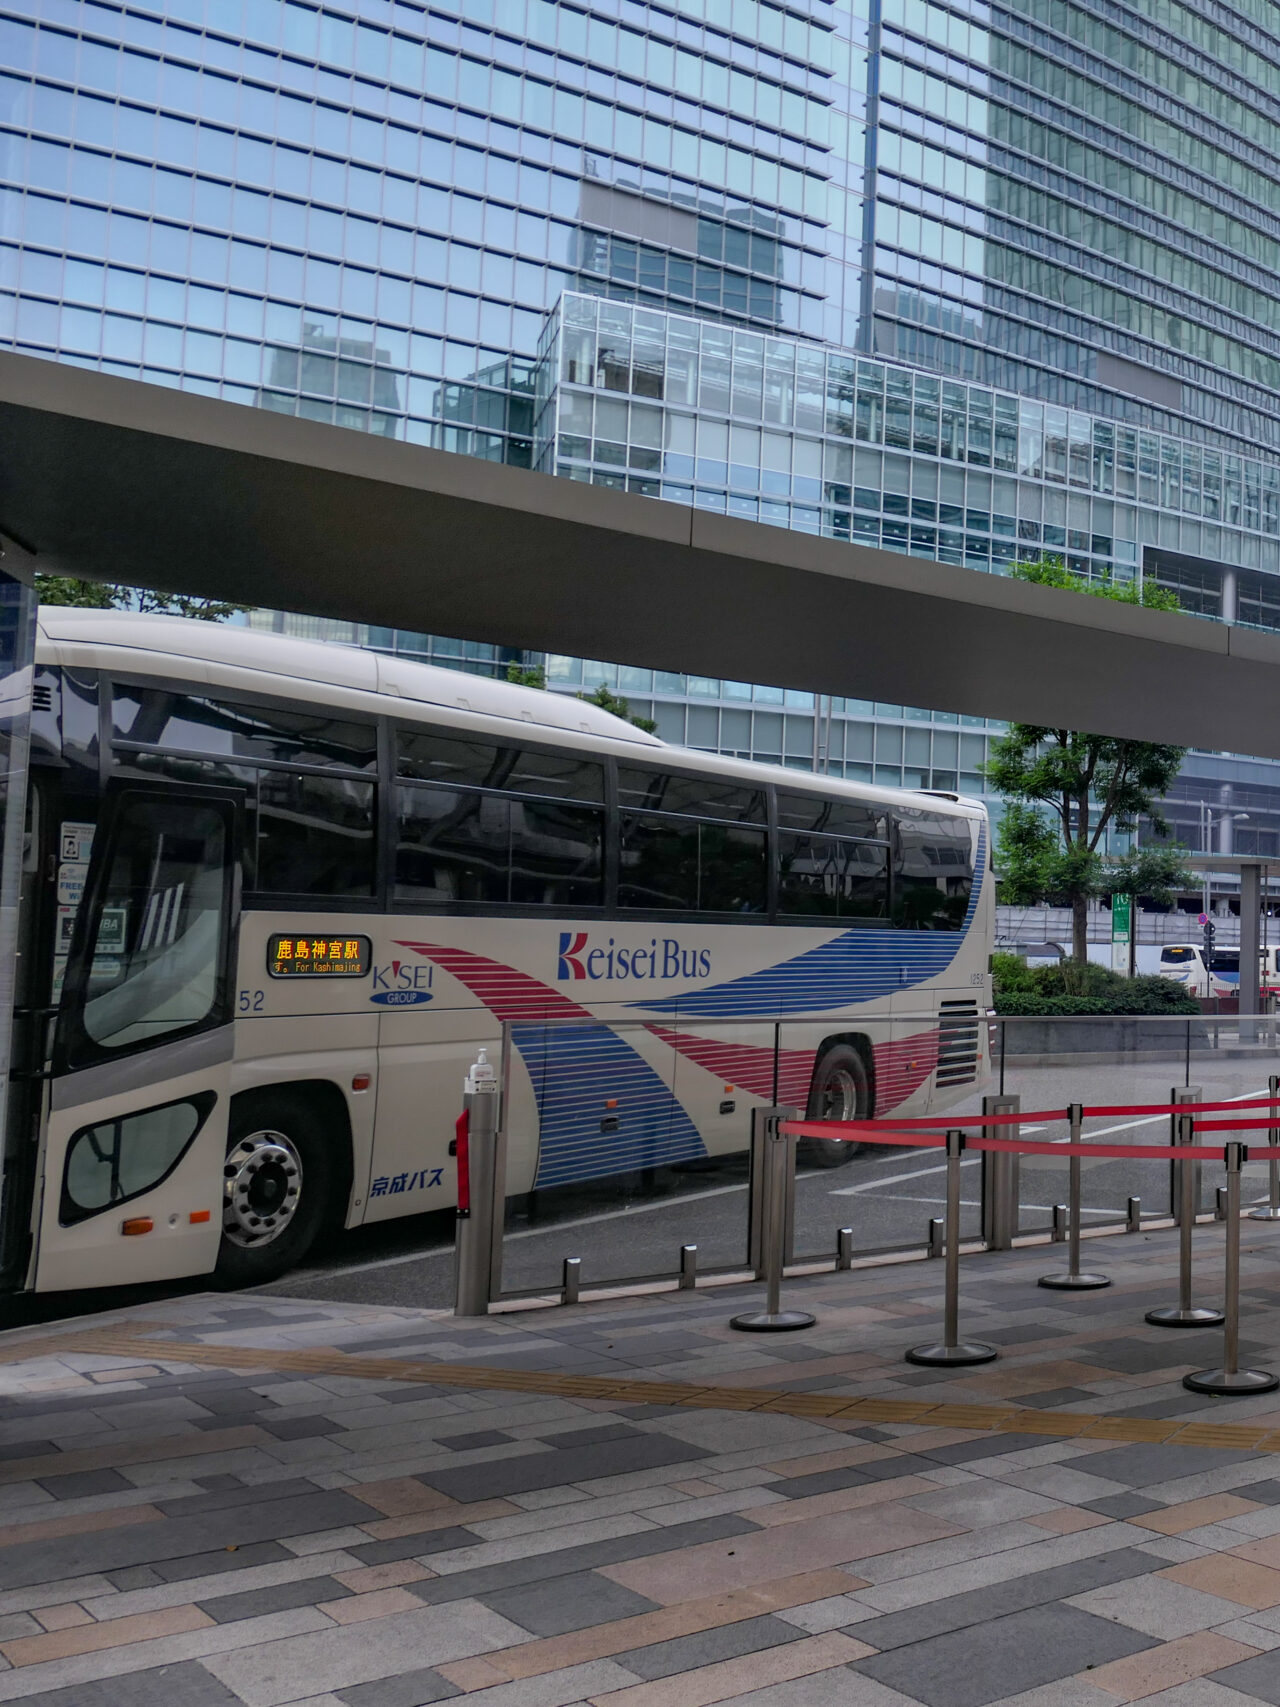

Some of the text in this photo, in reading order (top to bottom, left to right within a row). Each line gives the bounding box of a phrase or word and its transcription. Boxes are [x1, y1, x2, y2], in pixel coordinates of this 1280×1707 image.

[276, 940, 359, 959] 鹿島神宮駅
[295, 963, 310, 972] For
[970, 973, 984, 985] 1252
[387, 993, 417, 1004] GROUP
[370, 1168, 444, 1198] 京成バス
